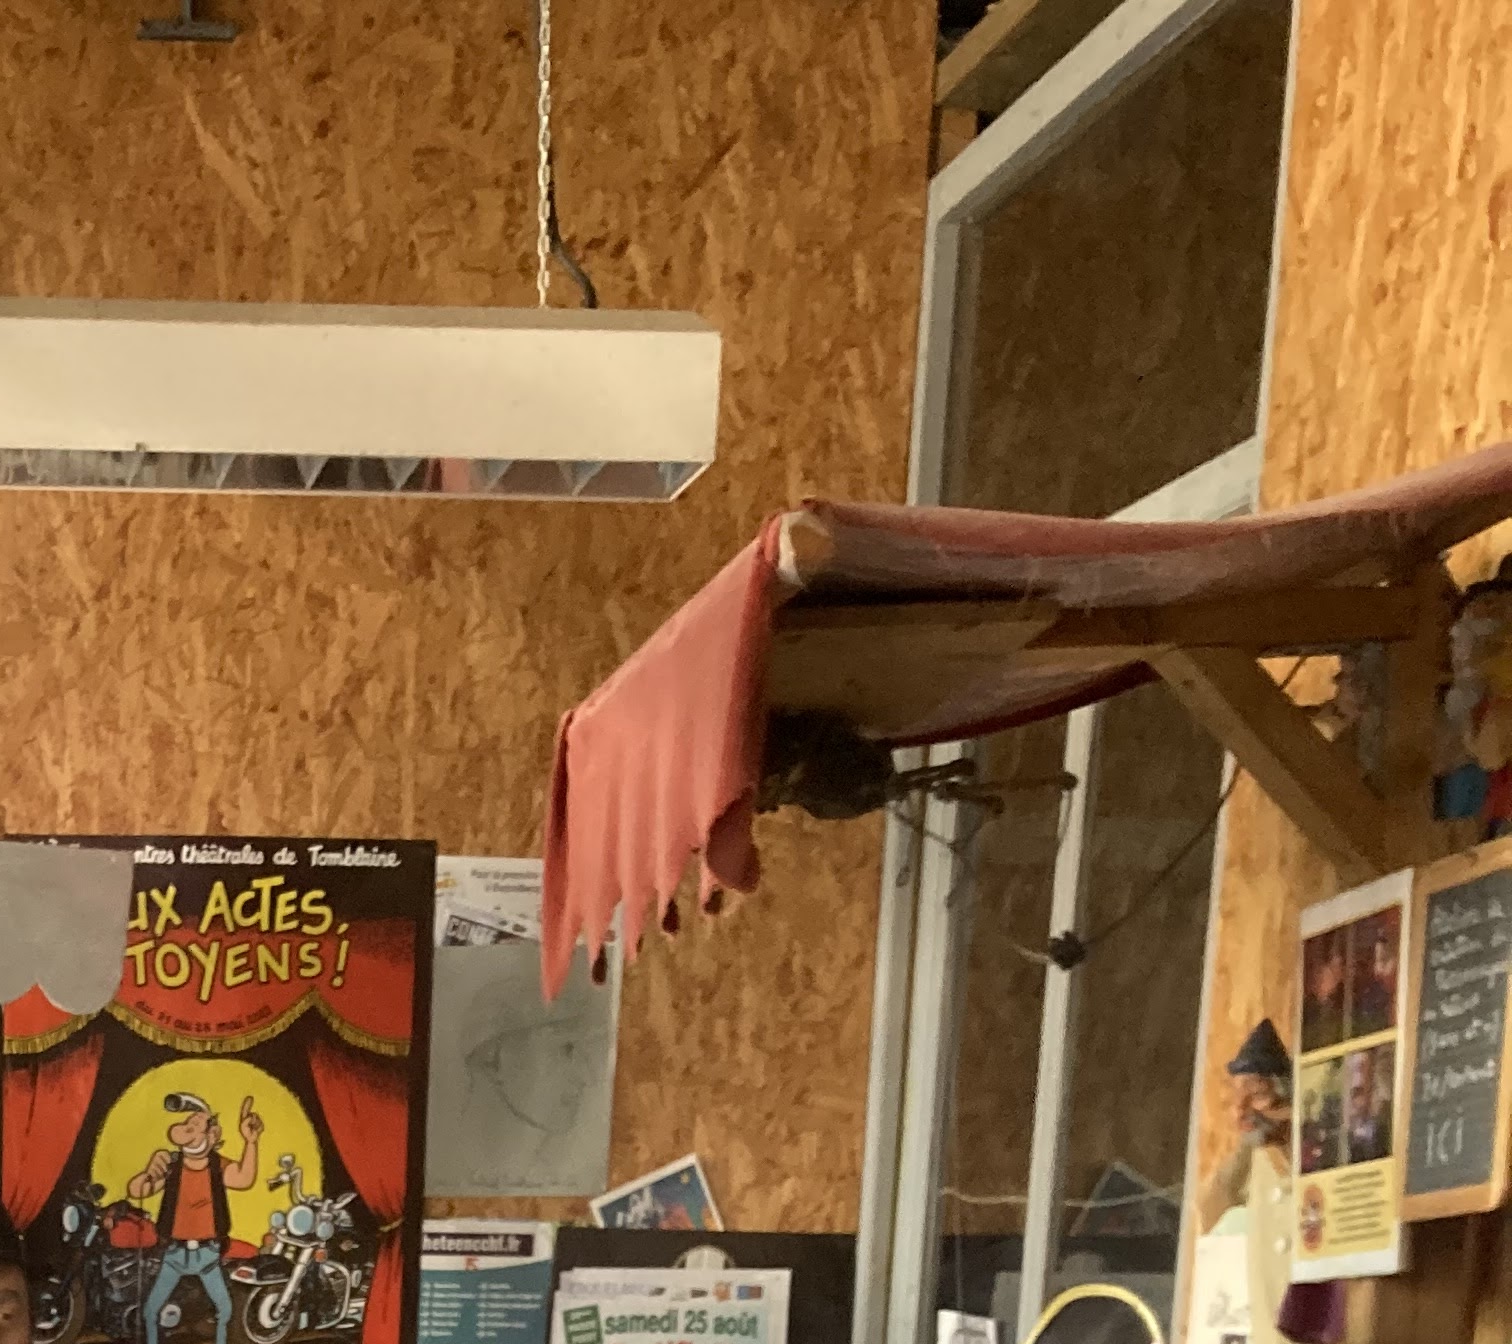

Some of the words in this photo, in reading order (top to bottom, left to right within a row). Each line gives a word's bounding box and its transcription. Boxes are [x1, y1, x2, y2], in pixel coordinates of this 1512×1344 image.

[273, 846, 297, 864] de
[308, 845, 400, 867] Tomblaine
[200, 876, 350, 934] ACTES,
[605, 1310, 678, 1334] samedi
[684, 1311, 707, 1334] 25
[714, 1312, 758, 1338] août
